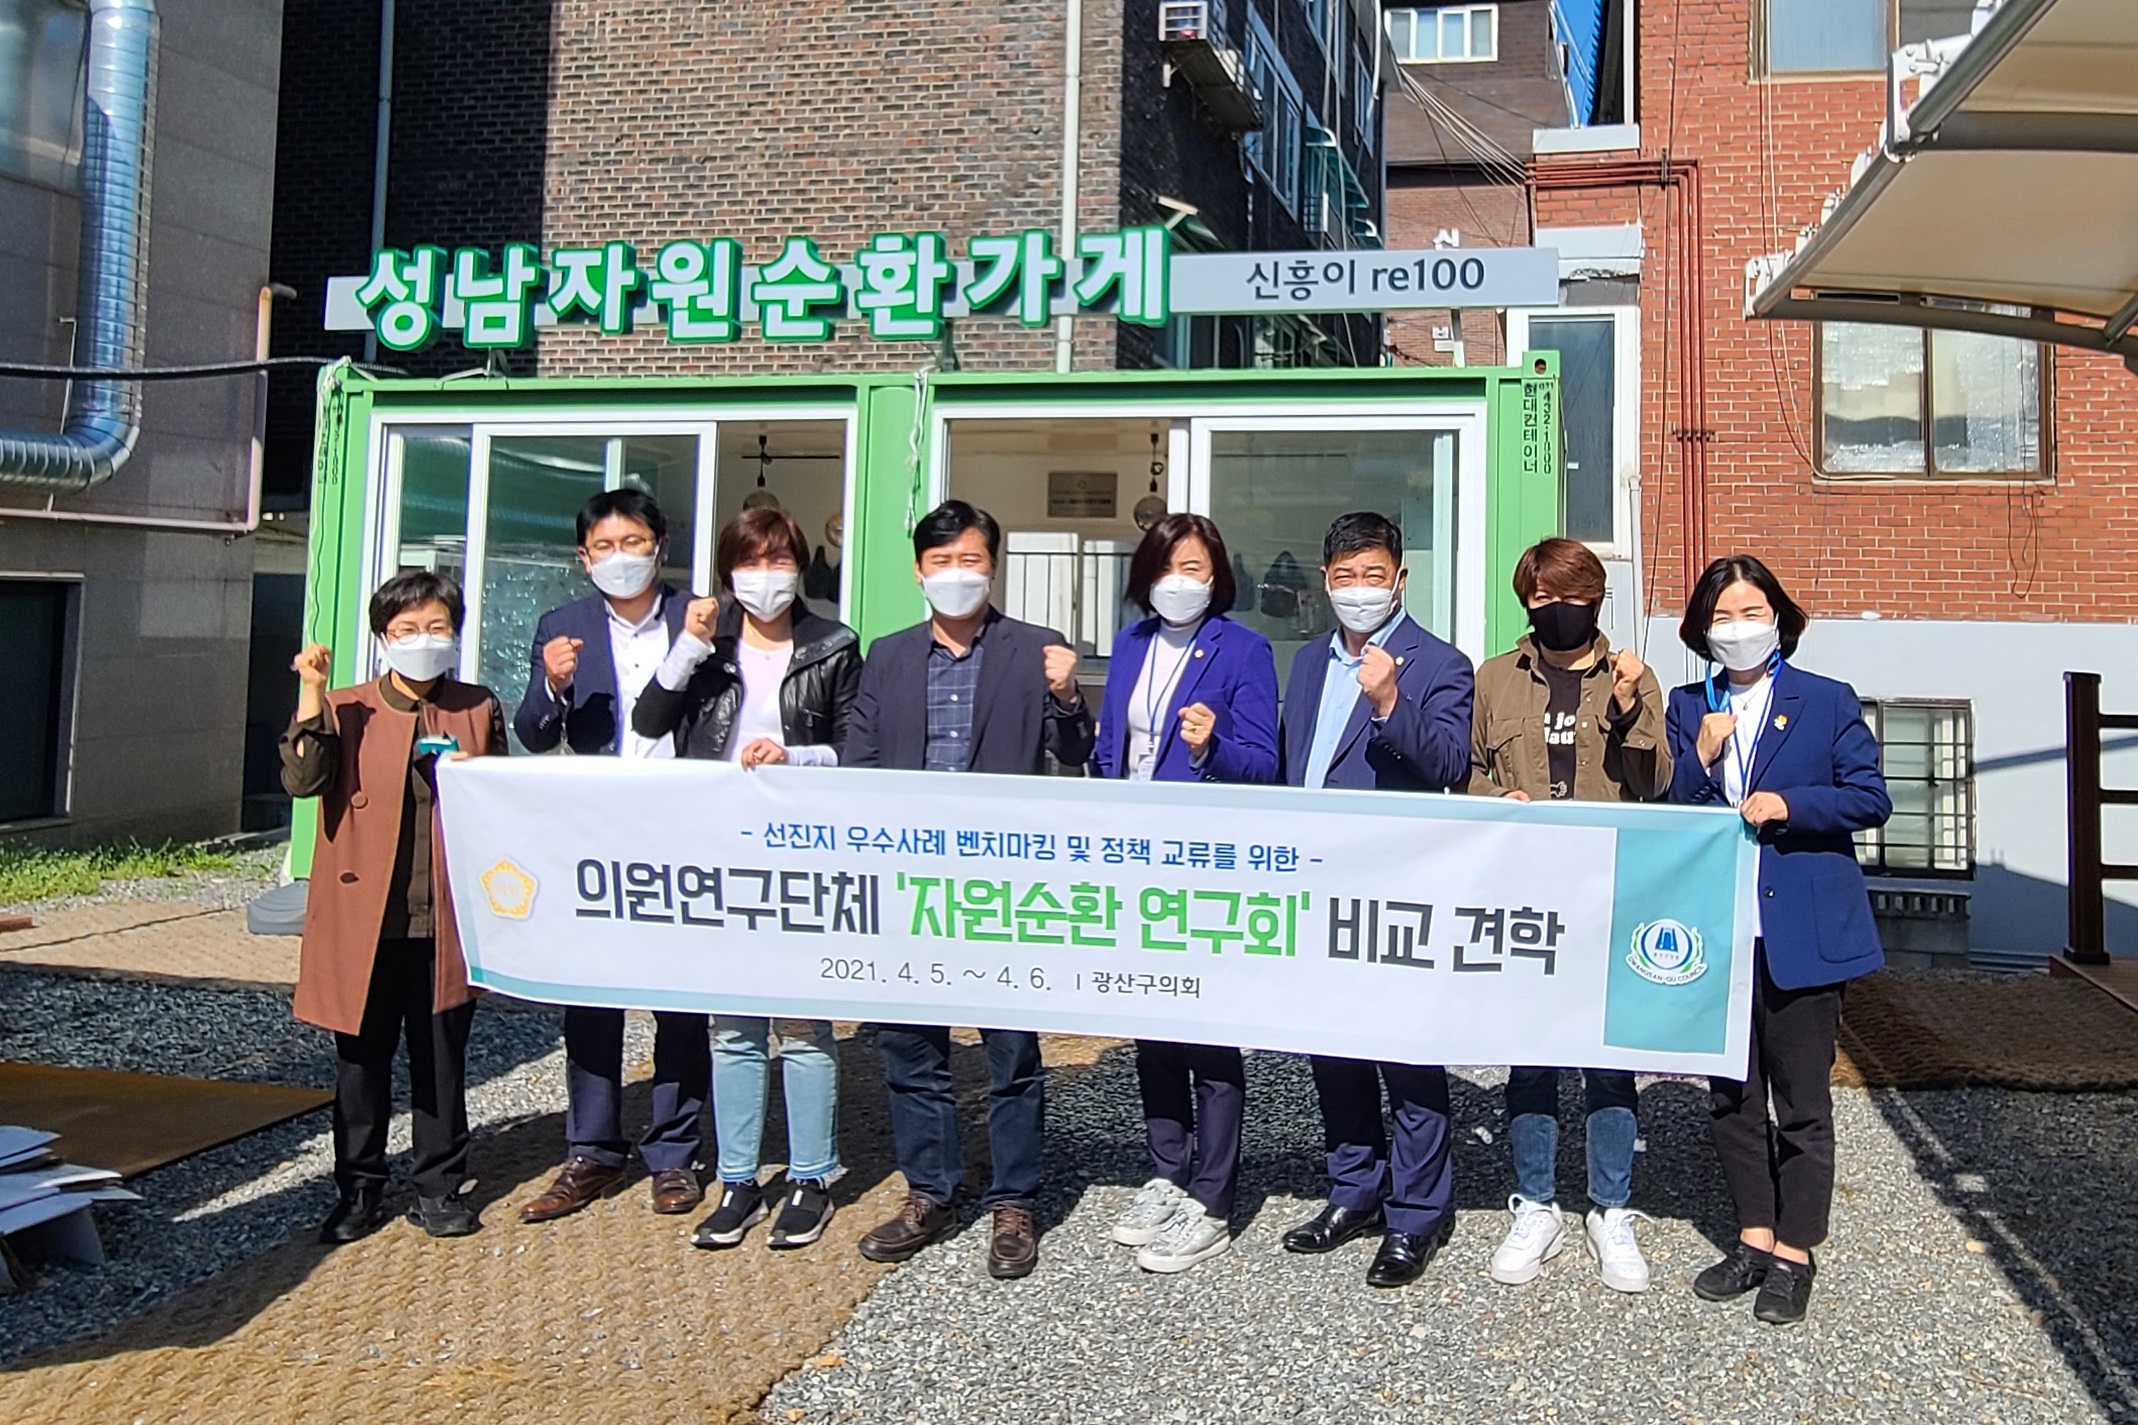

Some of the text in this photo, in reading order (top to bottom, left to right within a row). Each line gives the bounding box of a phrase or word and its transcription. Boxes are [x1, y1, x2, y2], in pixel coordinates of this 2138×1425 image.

[356, 225, 1169, 350] 성남자원순환가게
[1246, 257, 1485, 301] 신흥이 re100
[763, 822, 836, 851] 선진지
[846, 826, 946, 856] 우수사례
[956, 830, 1056, 861] 벤치마킹
[1067, 835, 1091, 863] 및
[1100, 836, 1151, 865] 정책
[1161, 840, 1238, 870] 교류를
[1247, 844, 1300, 873] 위한
[575, 858, 1566, 976] 의원연구단체 '자원순환 연구회' 비교 견학
[820, 957, 888, 984] 2021.
[1091, 971, 1201, 998] 광산구의회
